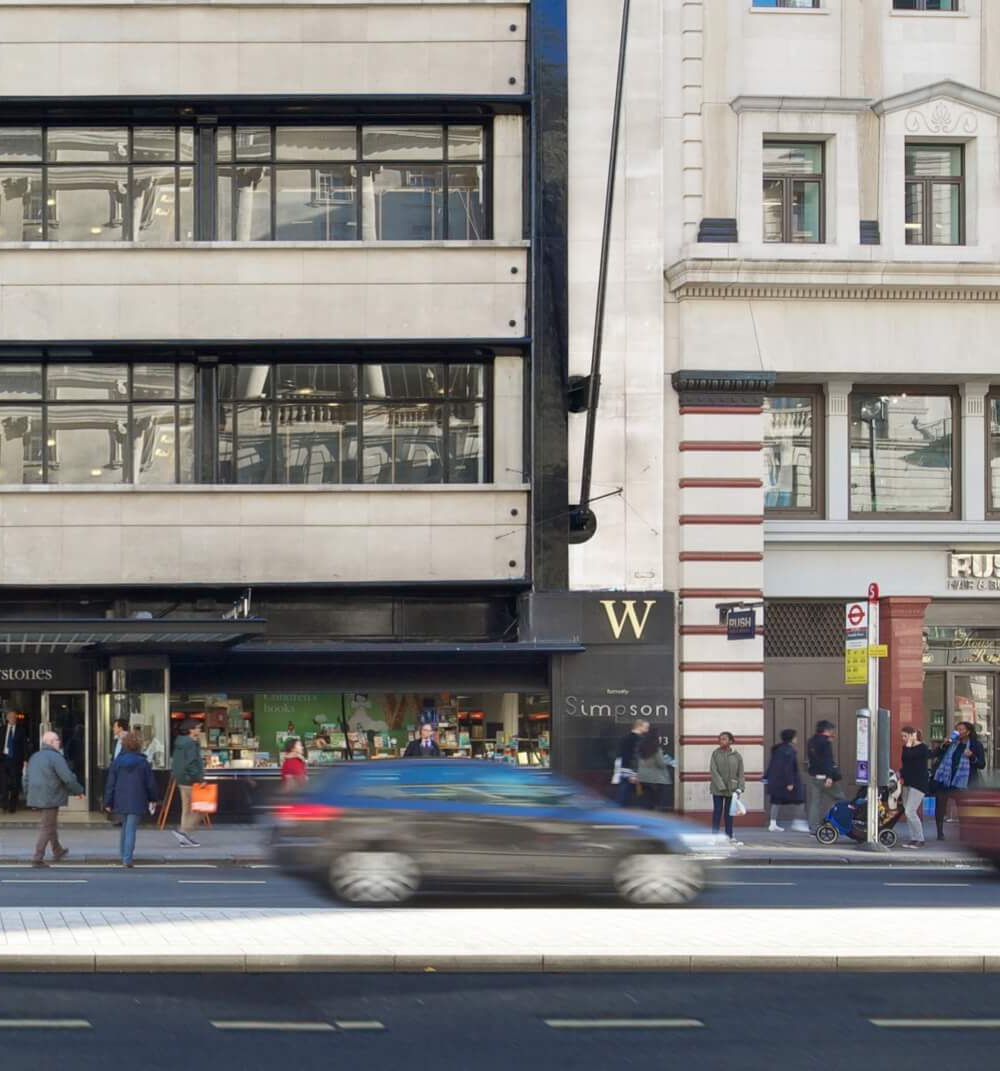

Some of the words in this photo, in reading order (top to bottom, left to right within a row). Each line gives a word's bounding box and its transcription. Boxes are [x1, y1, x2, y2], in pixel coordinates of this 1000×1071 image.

[600, 600, 656, 640] W
[729, 616, 751, 628] RUSH
[566, 695, 668, 718] Simpson
